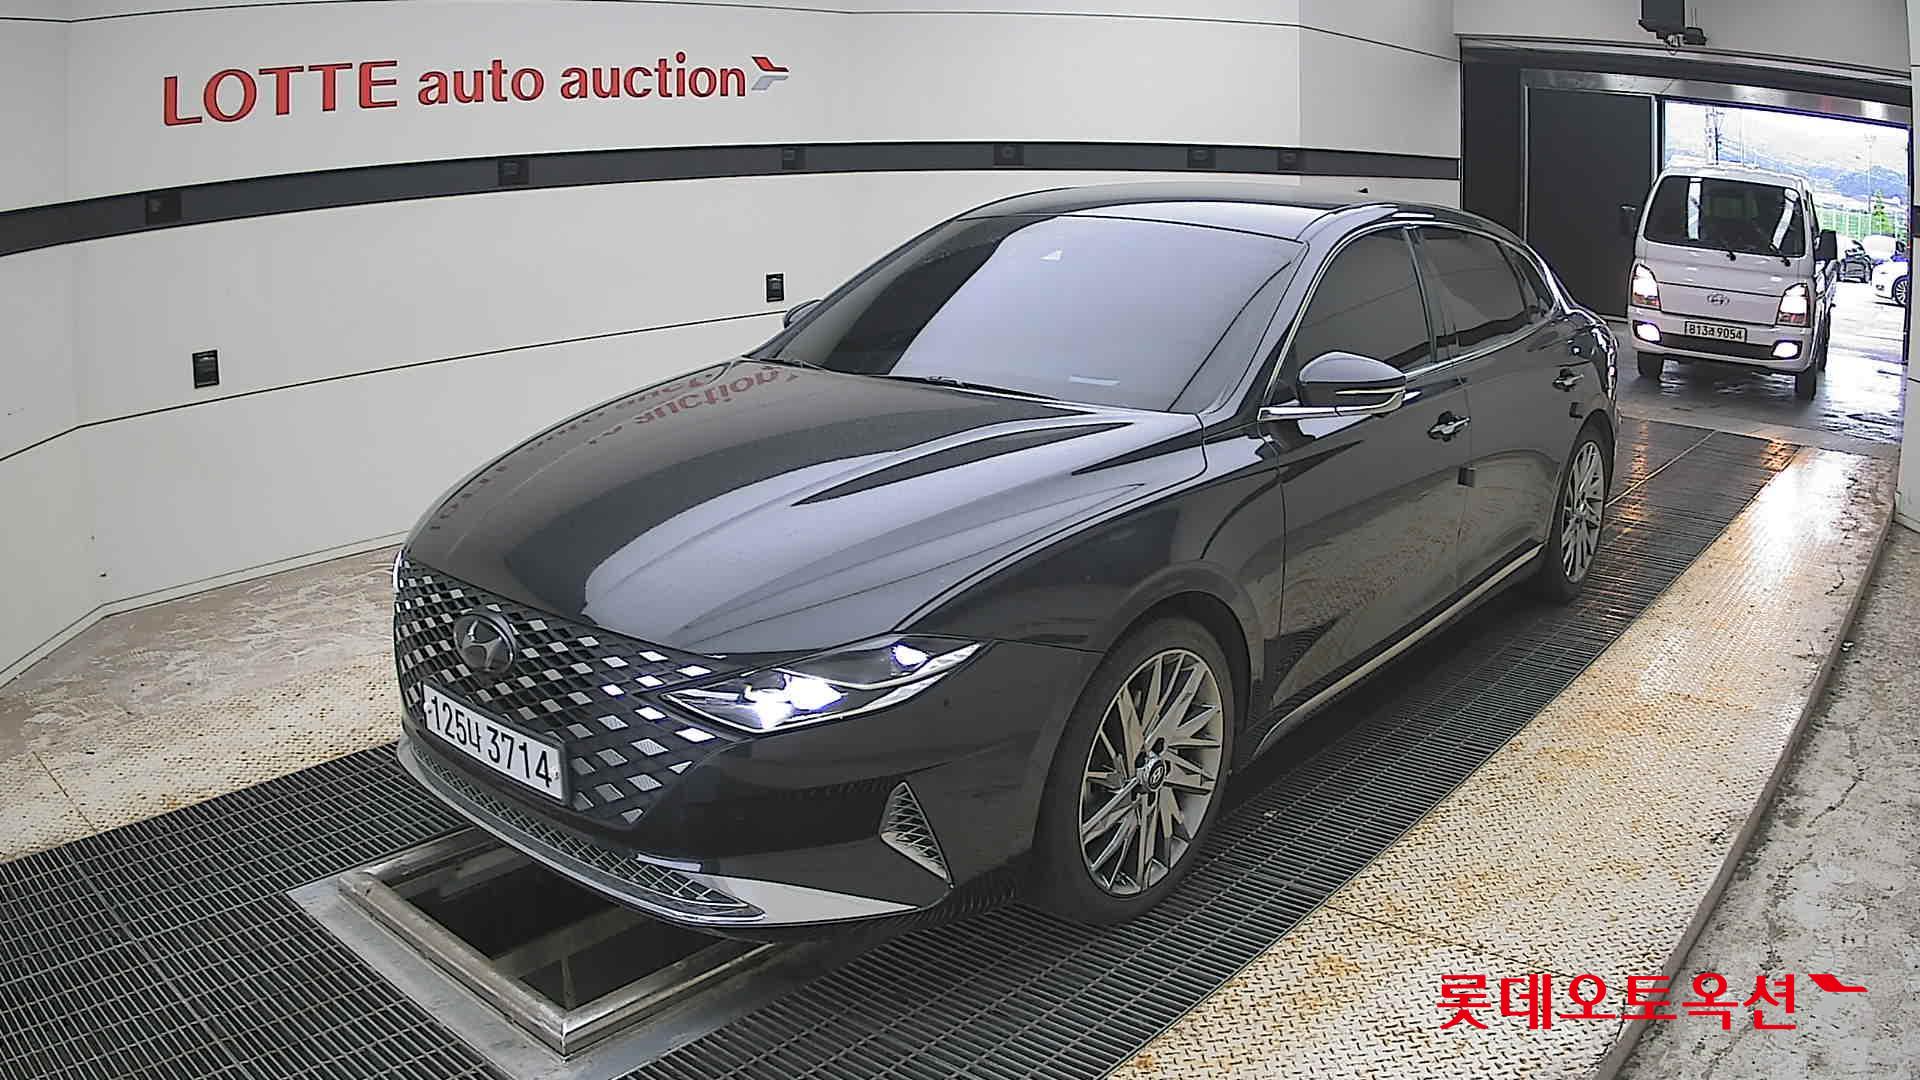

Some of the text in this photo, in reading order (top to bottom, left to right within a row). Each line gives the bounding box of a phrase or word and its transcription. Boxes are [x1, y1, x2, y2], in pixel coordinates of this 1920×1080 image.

[163, 51, 747, 126] LOTTE auto auction
[1716, 327, 1743, 340] 9054
[431, 696, 553, 788] 125나 3714
